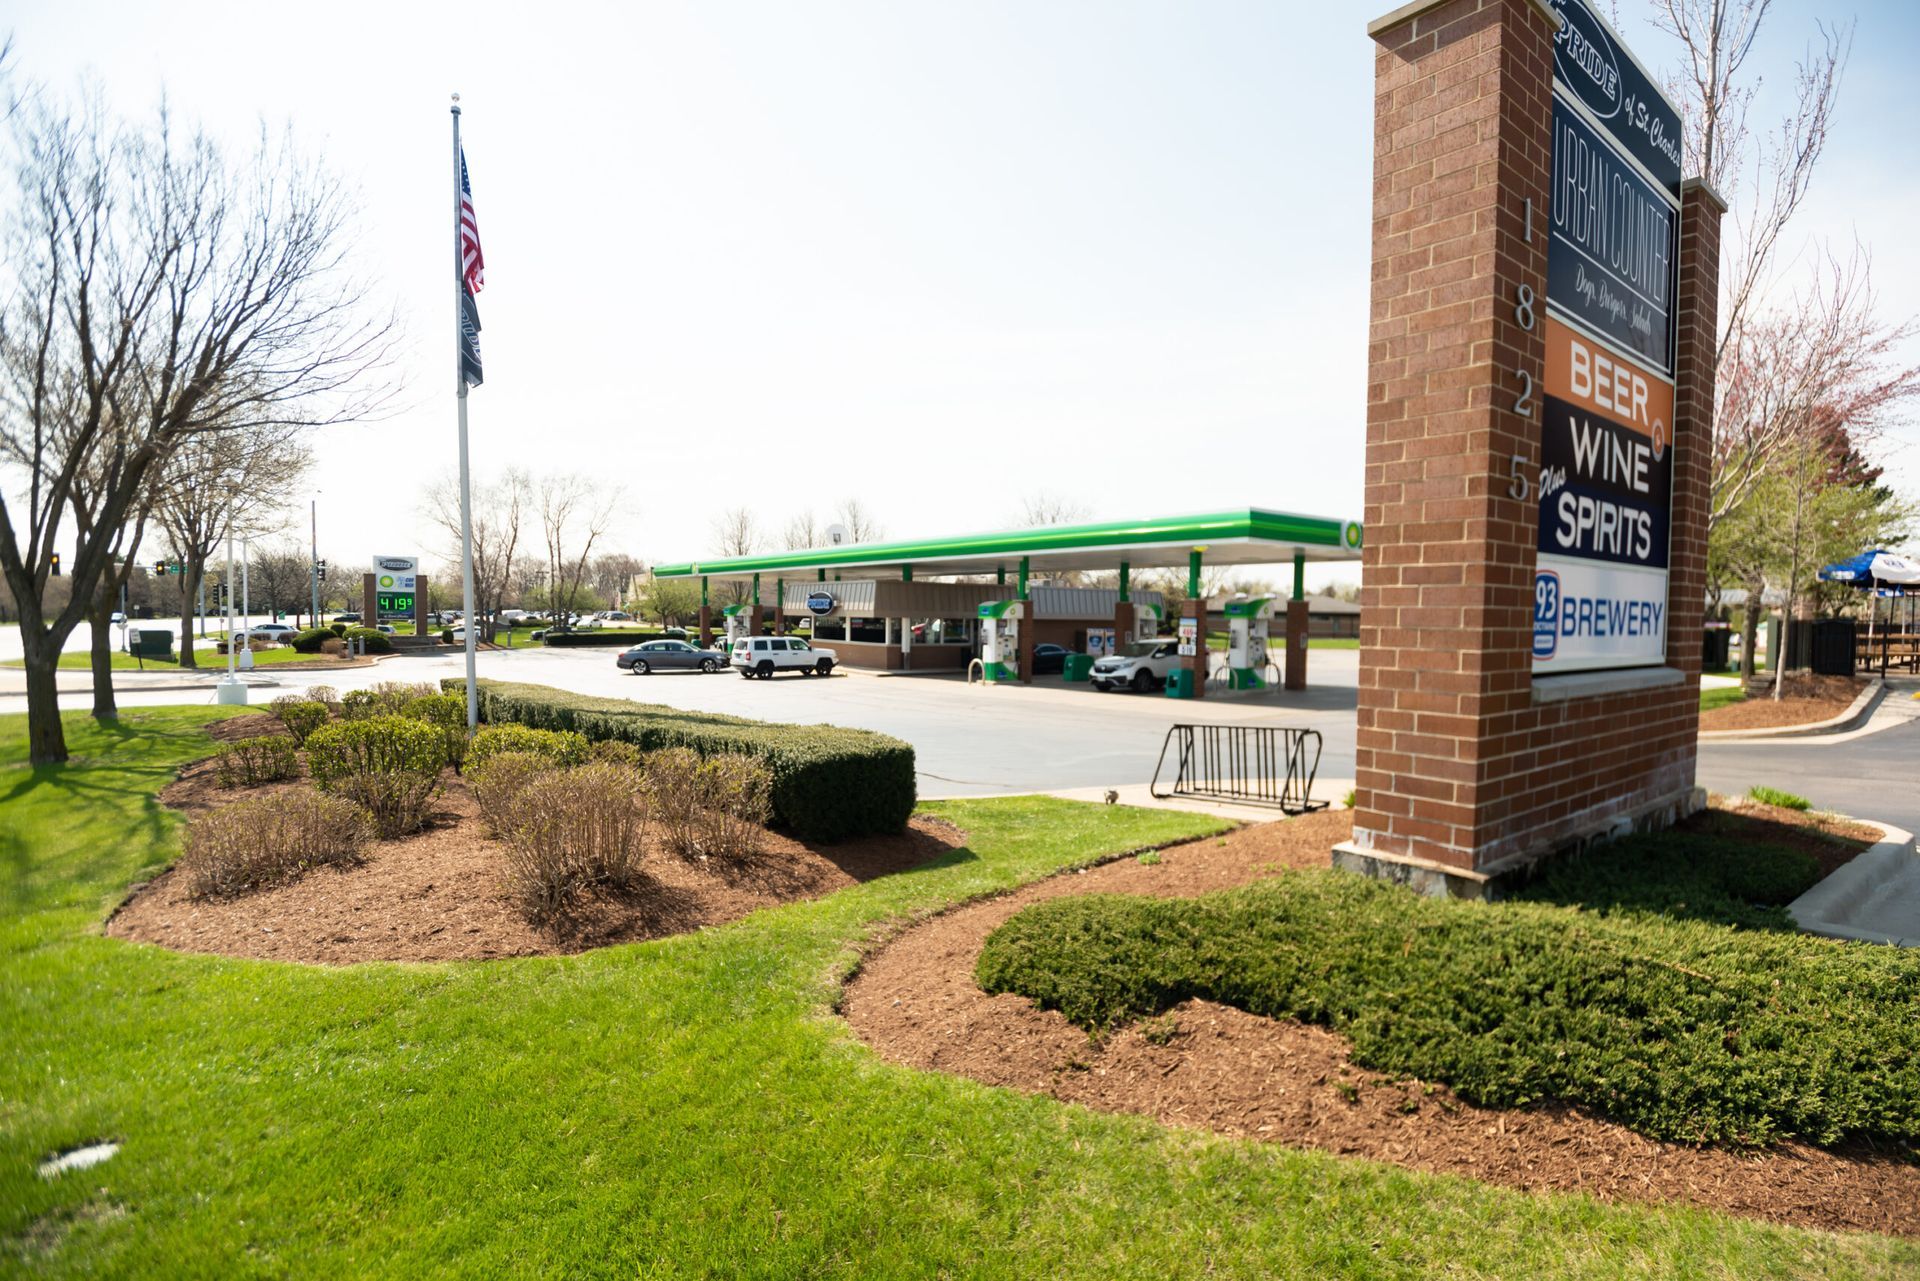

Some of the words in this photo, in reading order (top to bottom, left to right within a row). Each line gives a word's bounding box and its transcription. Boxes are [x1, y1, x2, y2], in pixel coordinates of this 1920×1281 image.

[1553, 7, 1618, 101] PRIDE
[1624, 93, 1635, 126] of
[1635, 102, 1650, 134] St.
[1650, 117, 1681, 168] Charles
[1553, 116, 1609, 260] URBAN
[1611, 172, 1671, 308] COUNTER
[1571, 340, 1649, 427] BEER
[1569, 416, 1651, 493] WINE
[1556, 491, 1651, 560] SPIRITS
[1536, 580, 1557, 619] 93
[1561, 597, 1664, 638] BREWERY
